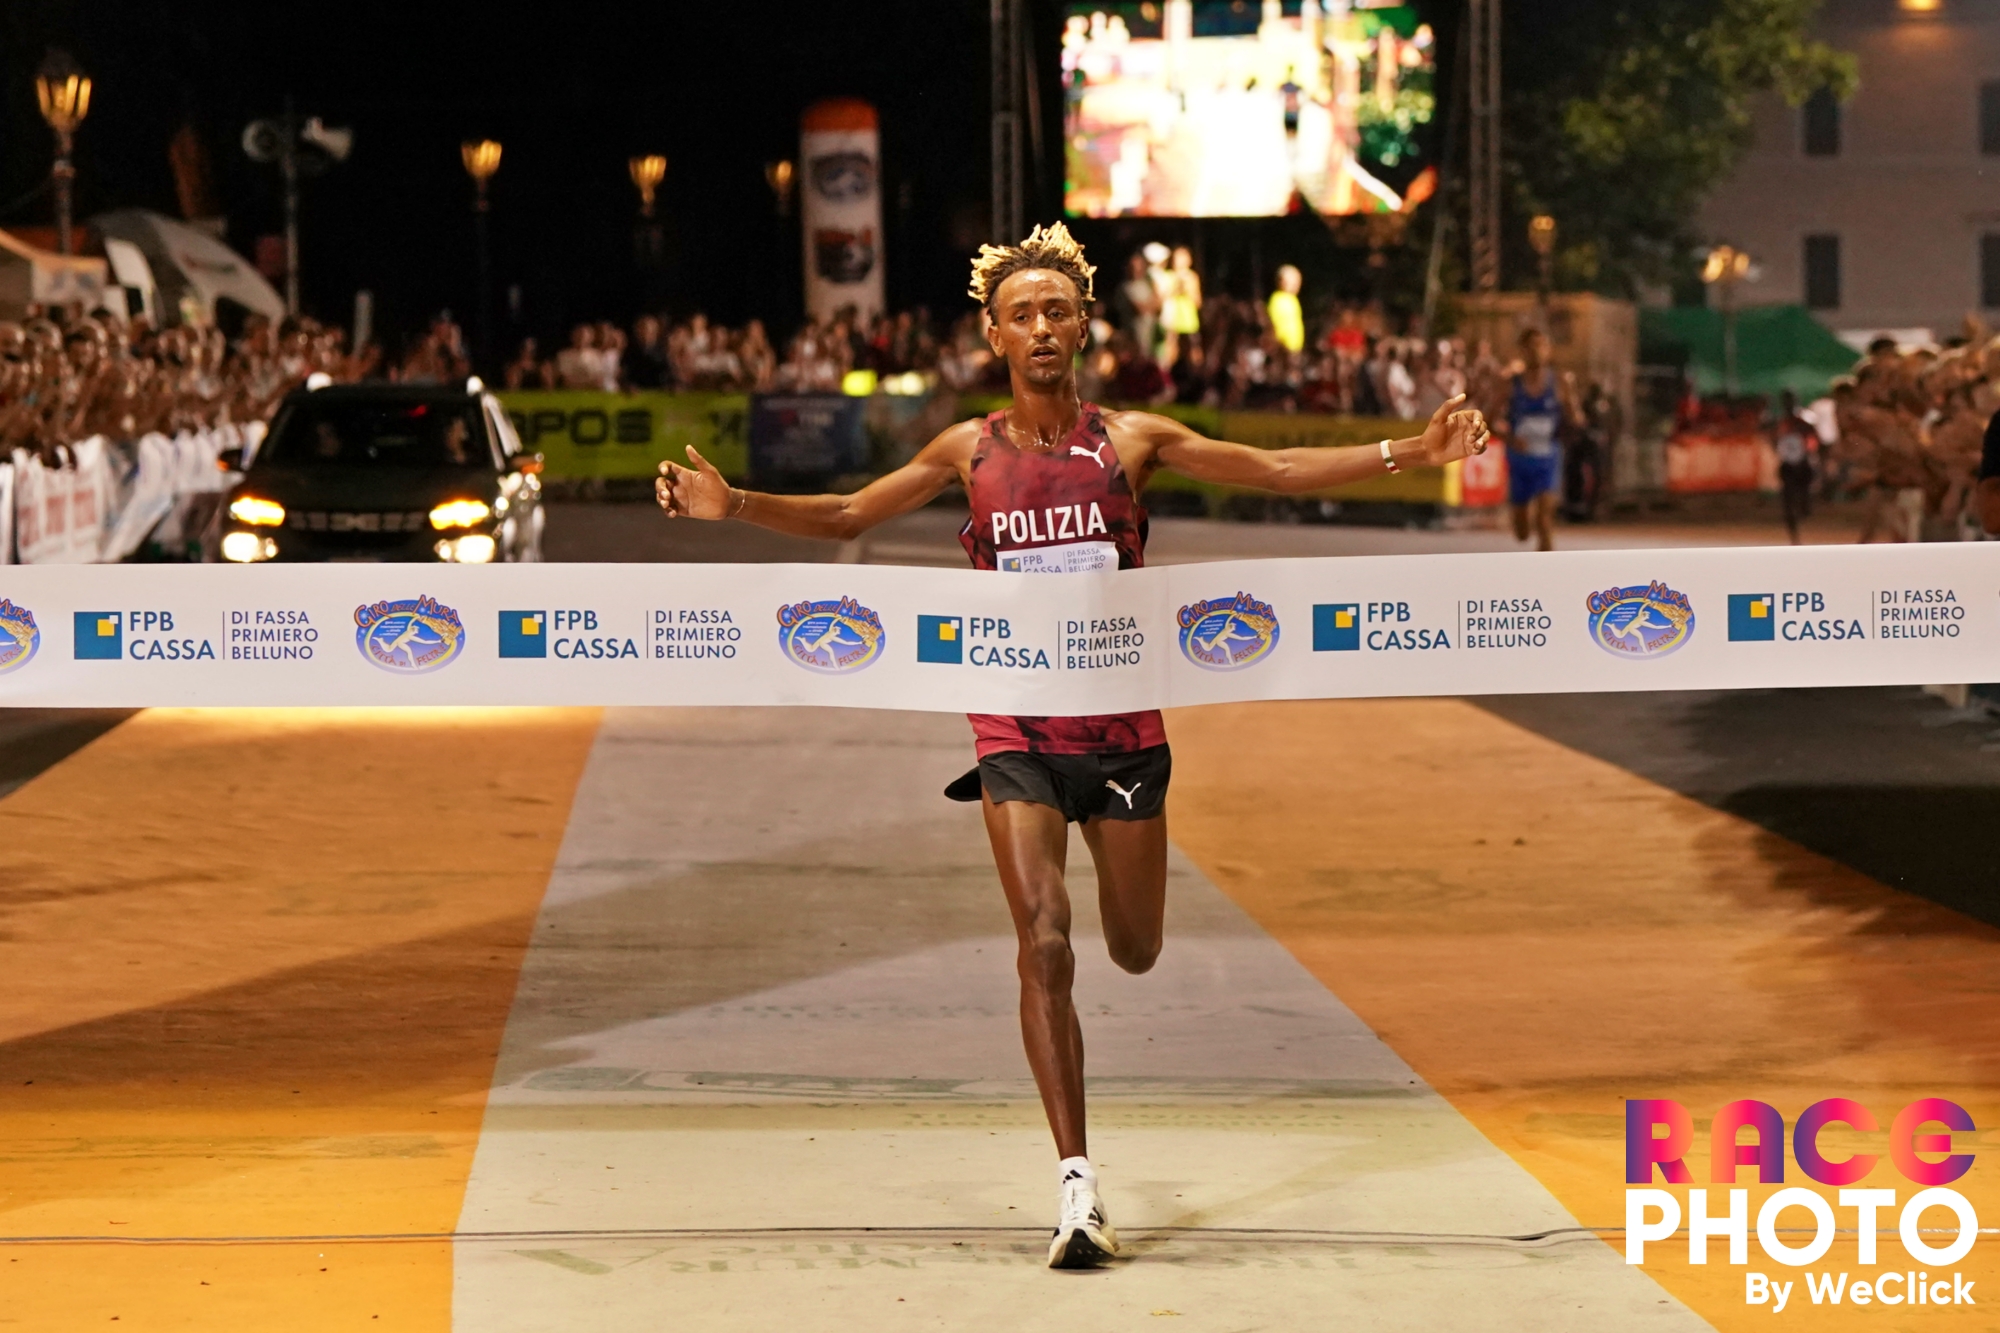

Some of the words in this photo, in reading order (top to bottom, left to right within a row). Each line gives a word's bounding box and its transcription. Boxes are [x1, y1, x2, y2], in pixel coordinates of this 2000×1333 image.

[991, 502, 1108, 545] POLIZIA
[1023, 554, 1043, 566] FPB
[1066, 550, 1076, 558] DI
[1077, 548, 1101, 556] FASSA
[1067, 554, 1106, 565] PRIMIERO
[1068, 562, 1104, 573] BELLUNO
[1586, 587, 1622, 614] GIRO
[1644, 580, 1690, 609] MURA
[1782, 592, 1825, 613] FPB
[1880, 590, 1898, 604] DI
[1904, 590, 1956, 604] FASSA
[354, 600, 392, 628] GIRO
[412, 594, 460, 624] MURA
[777, 600, 813, 627] GIRO
[835, 595, 880, 626] MURA
[1177, 600, 1209, 628] GIRO
[1230, 591, 1275, 619] MURA
[1367, 602, 1410, 623] FPB
[1466, 600, 1484, 614] DI
[1490, 599, 1543, 613] FASSA
[1880, 606, 1965, 621] PRIMIERO
[130, 611, 174, 631] FPB
[231, 611, 249, 625] DI
[256, 611, 309, 625] FASSA
[554, 609, 599, 630] FPB
[655, 610, 672, 624] DI
[679, 610, 732, 624] FASSA
[1067, 620, 1084, 634] DI
[1091, 616, 1137, 634] FASSA
[1466, 616, 1552, 631] PRIMIERO
[231, 628, 318, 642] PRIMIERO
[655, 627, 742, 641] PRIMIERO
[969, 617, 1012, 638] FPB
[1781, 620, 1866, 641] CASSA
[1881, 624, 1961, 639] BELLUNO
[554, 638, 639, 659] CASSA
[1067, 633, 1145, 652] PRIMIERO
[1366, 629, 1452, 651] CASSA
[1466, 633, 1547, 648] BELLUNO
[130, 640, 215, 660] CASSA
[231, 646, 313, 660] BELLUNO
[655, 645, 736, 659] BELLUNO
[969, 646, 1051, 670] CASSA
[1067, 651, 1141, 670] BELLUNO
